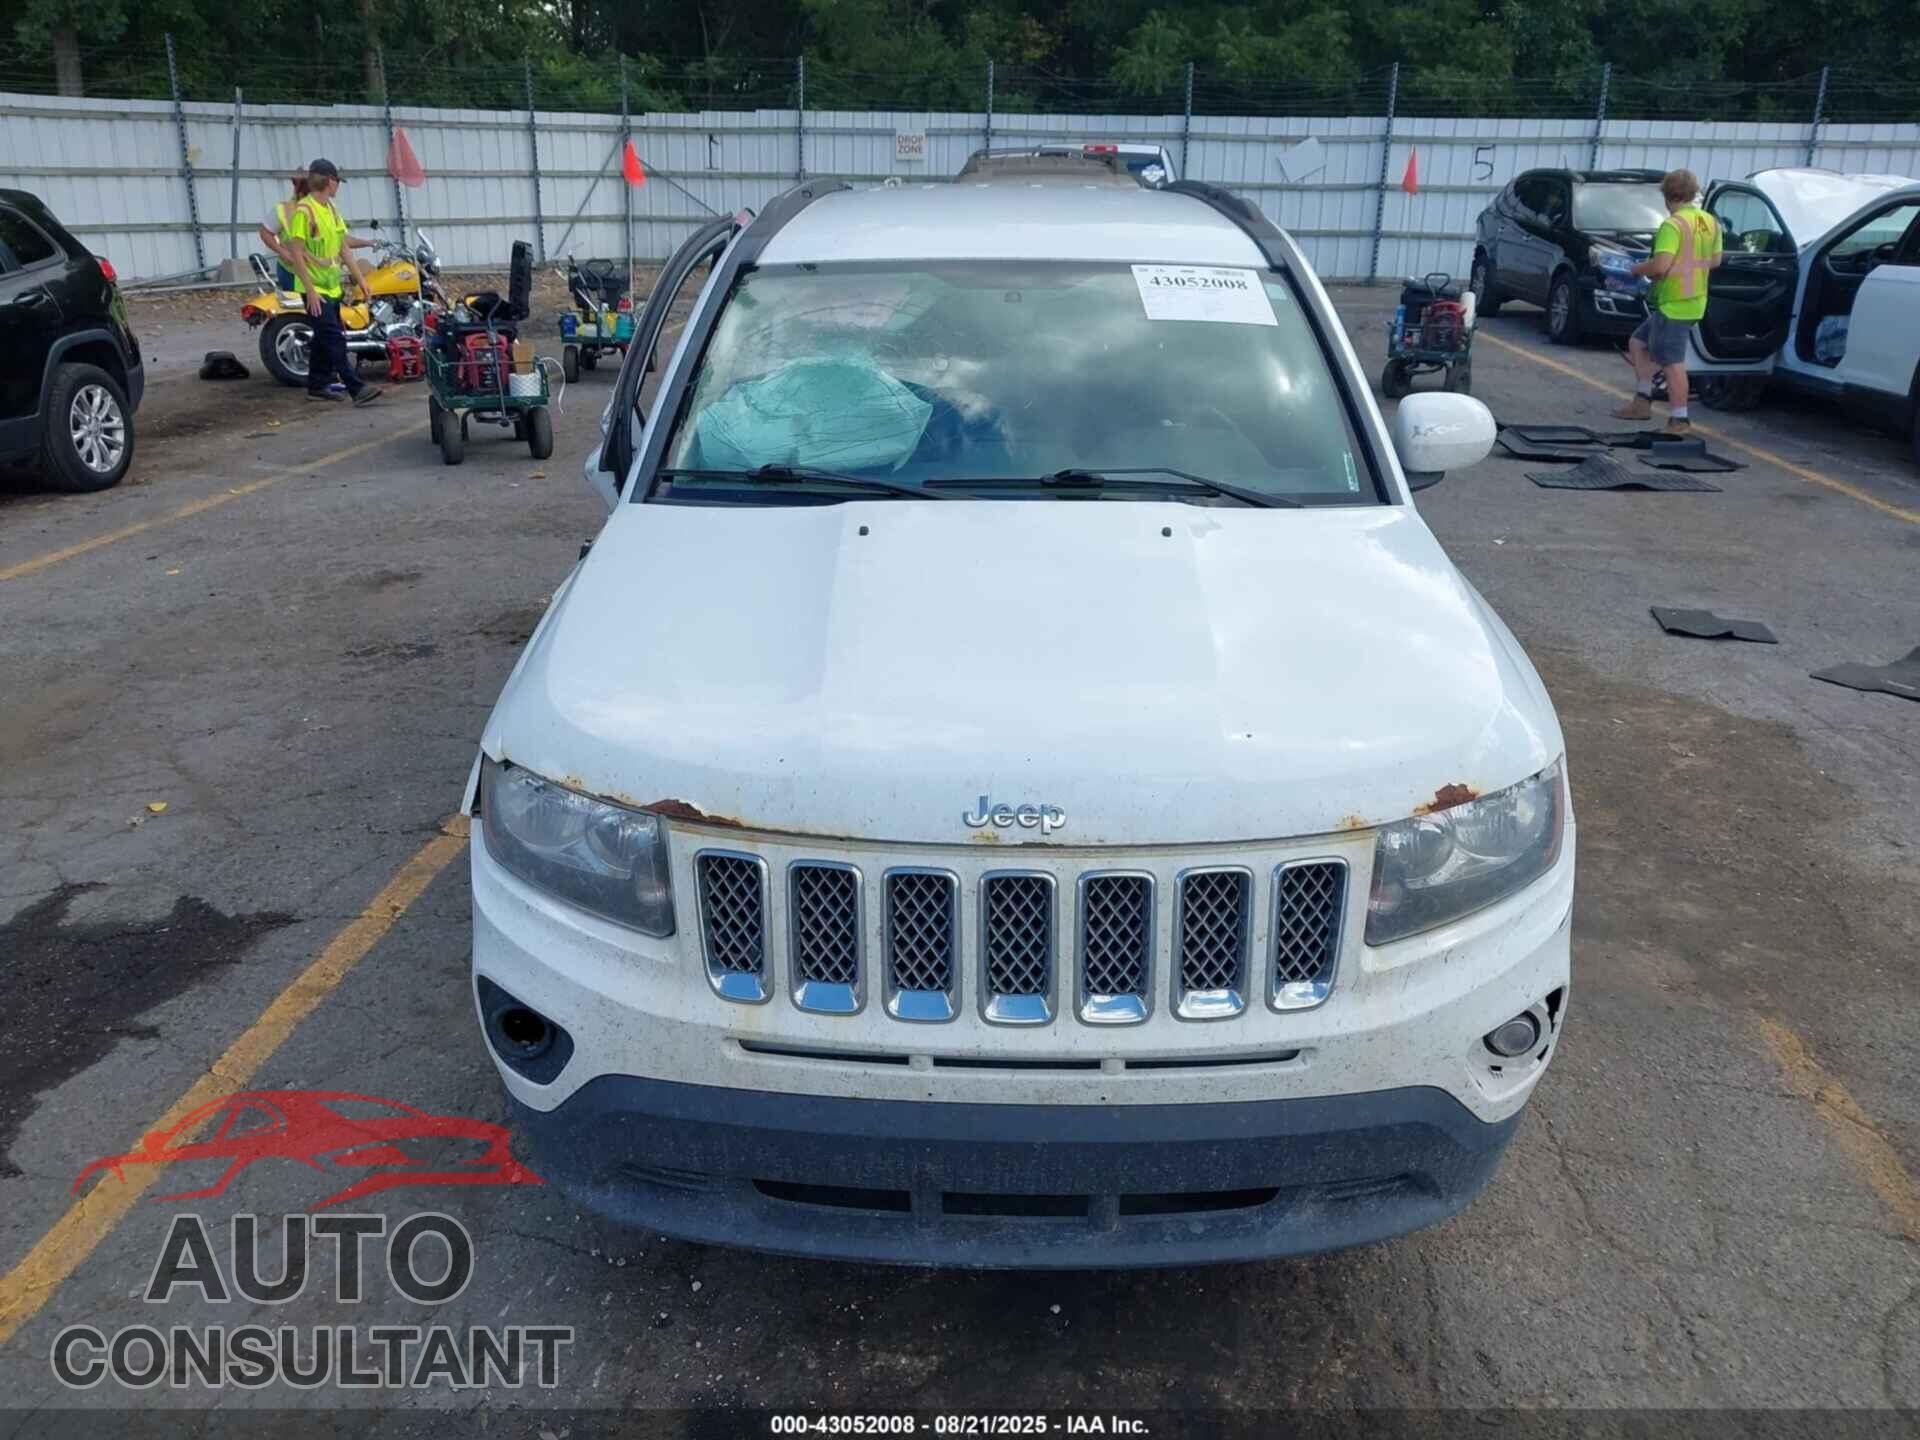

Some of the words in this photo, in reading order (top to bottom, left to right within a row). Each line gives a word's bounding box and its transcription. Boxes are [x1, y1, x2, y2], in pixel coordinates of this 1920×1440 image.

[897, 135, 924, 145] DROP
[897, 145, 922, 154] ZONE
[1474, 143, 1496, 181] 5
[1149, 275, 1248, 291] 43052008
[962, 794, 1067, 836] Jeep
